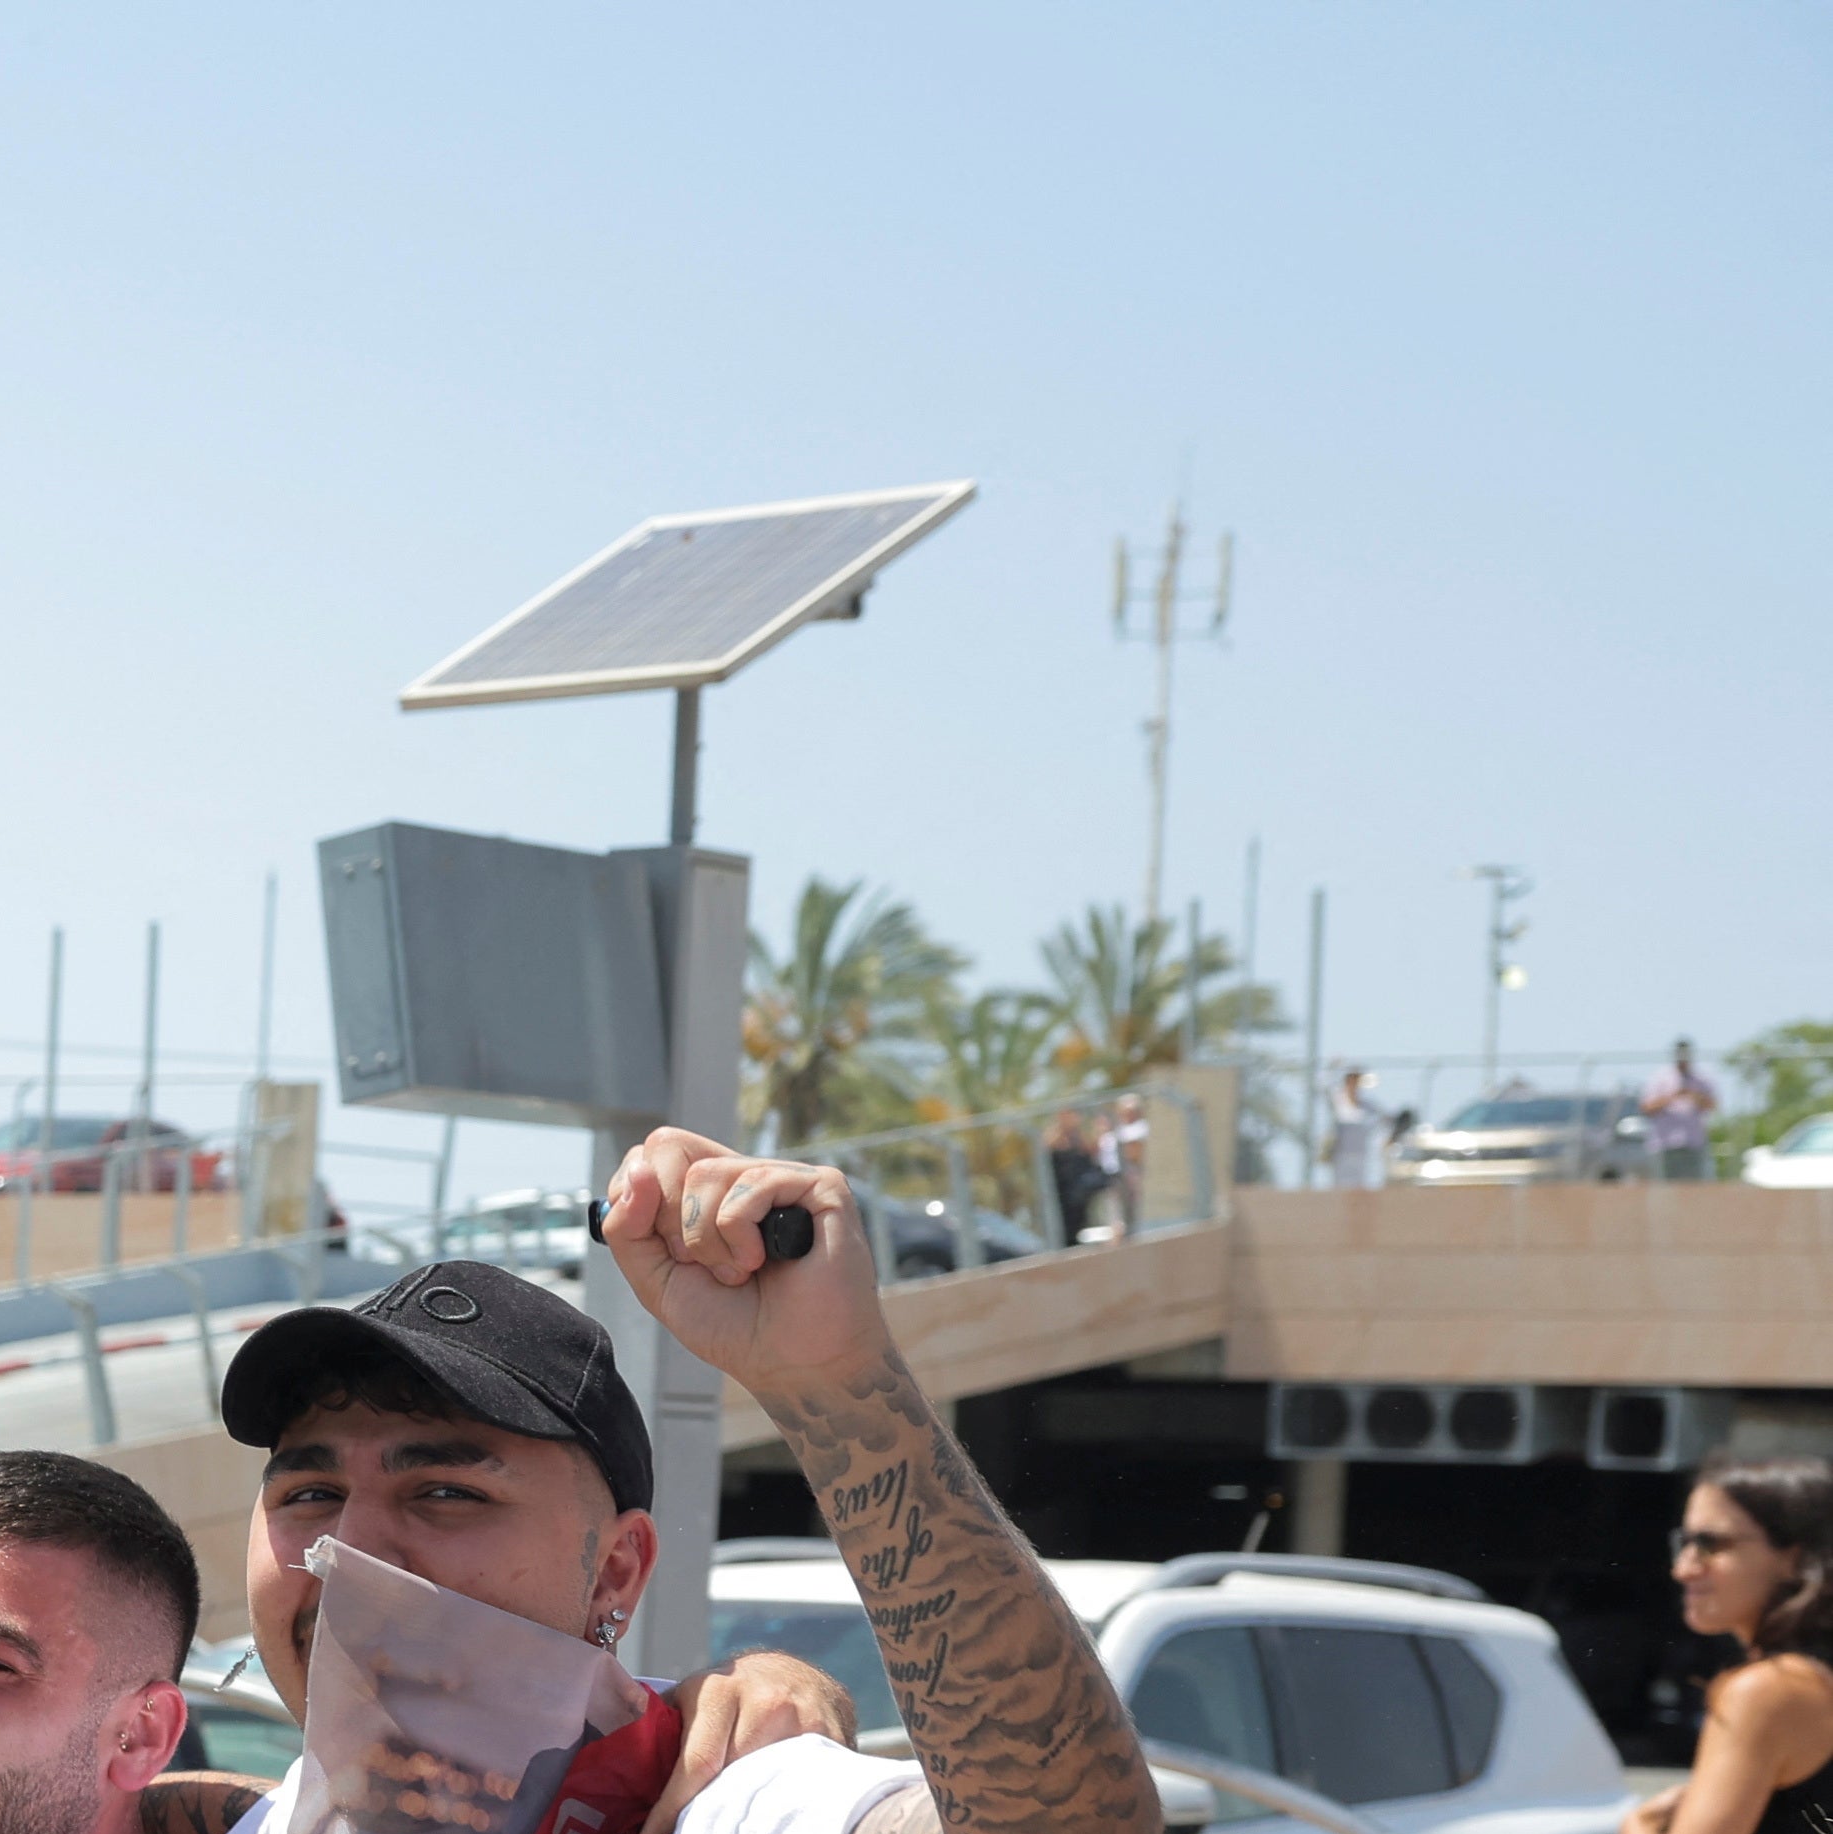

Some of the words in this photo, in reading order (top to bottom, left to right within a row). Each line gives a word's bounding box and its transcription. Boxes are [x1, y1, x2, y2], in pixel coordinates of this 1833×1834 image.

[833, 1459, 908, 1530] laws
[861, 1545, 898, 1589] the
[899, 1505, 932, 1583] of
[889, 1631, 948, 1697] from
